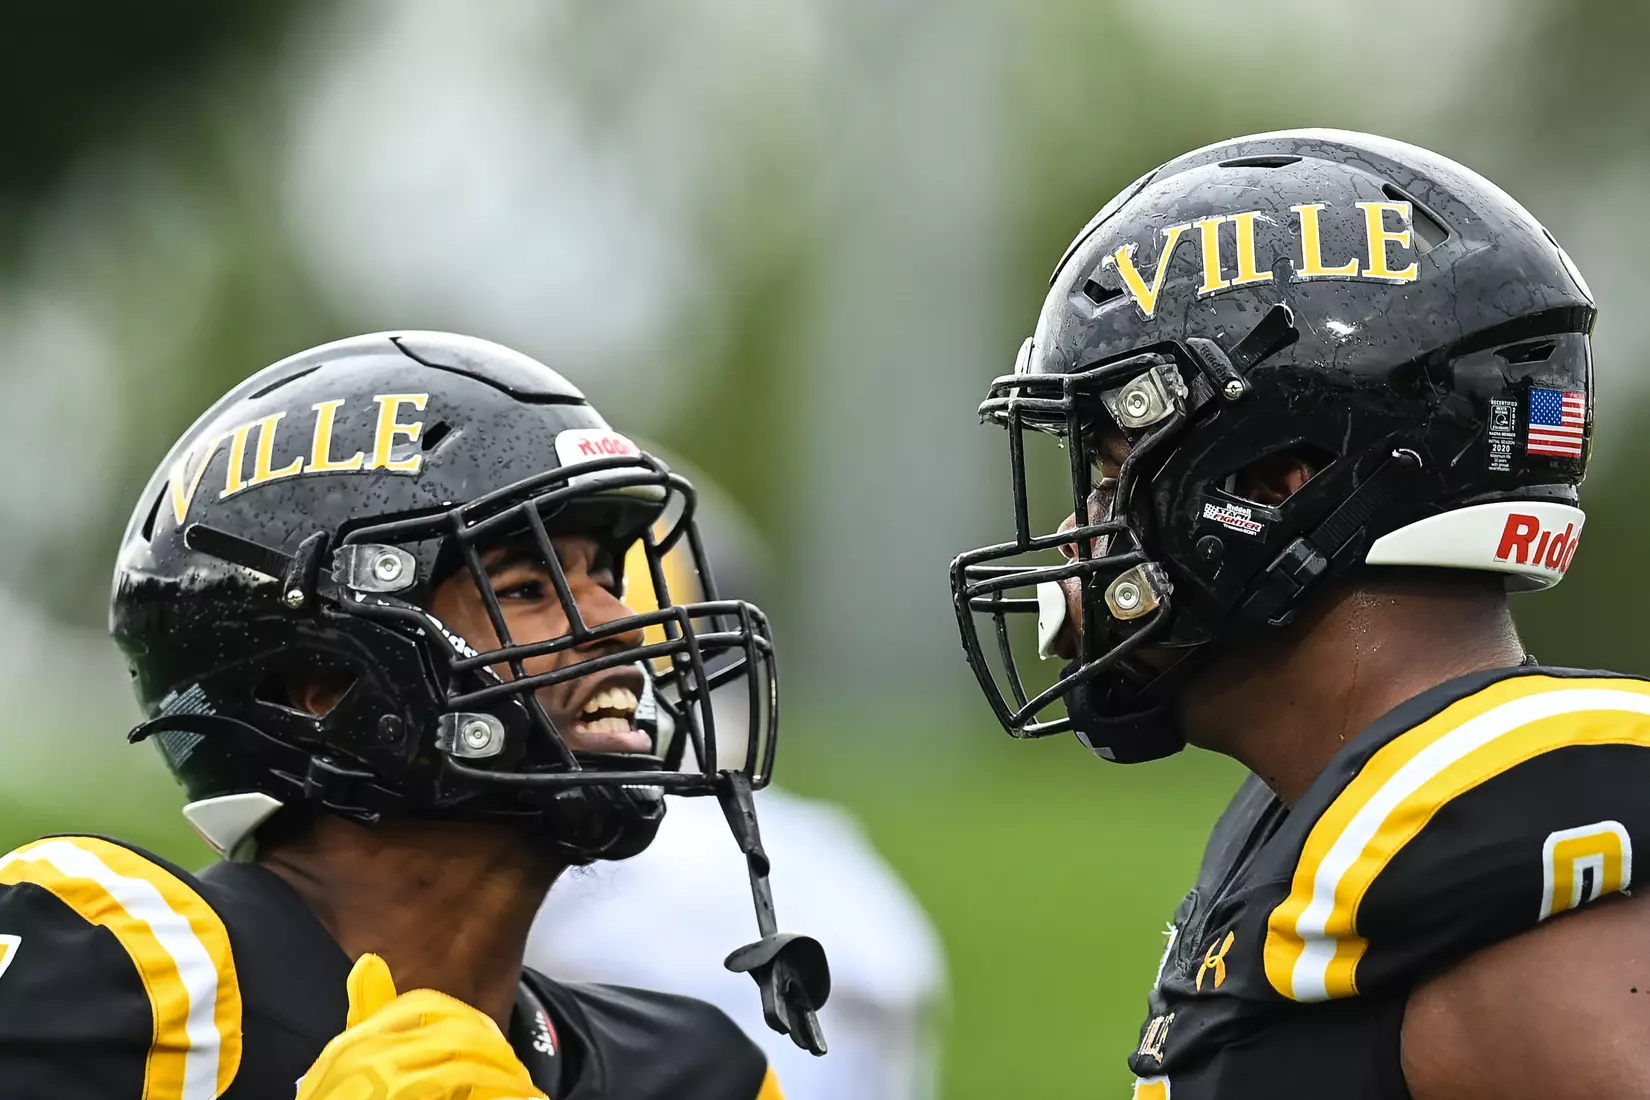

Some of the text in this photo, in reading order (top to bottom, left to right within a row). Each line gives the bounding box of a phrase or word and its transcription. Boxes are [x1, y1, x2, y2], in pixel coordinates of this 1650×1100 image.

[1102, 201, 1420, 316] VILLE
[167, 393, 430, 525] VILLE
[1492, 444, 1510, 452] 2020
[1212, 513, 1260, 531] FIGHTER
